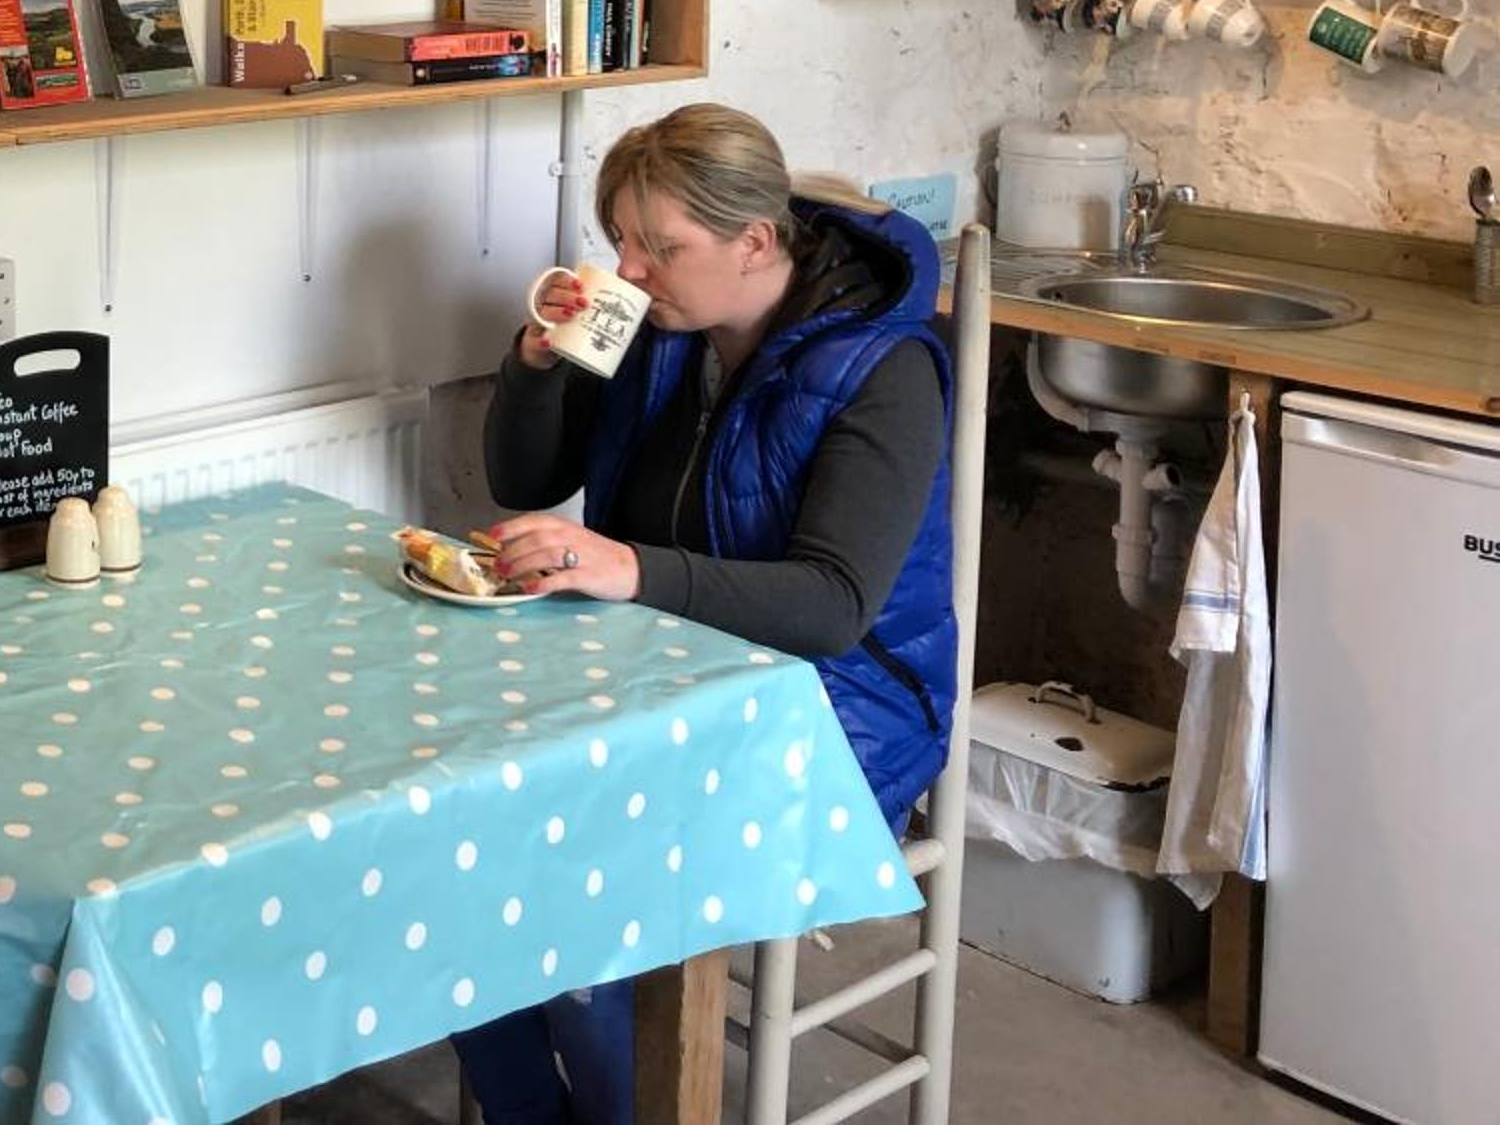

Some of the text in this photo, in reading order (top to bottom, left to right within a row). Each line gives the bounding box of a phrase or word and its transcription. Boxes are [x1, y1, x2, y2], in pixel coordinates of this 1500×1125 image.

[234, 42, 245, 83] Walks
[41, 400, 79, 424] Coffee
[21, 436, 53, 456] Food
[32, 469, 55, 486] add
[7, 503, 33, 519] each
